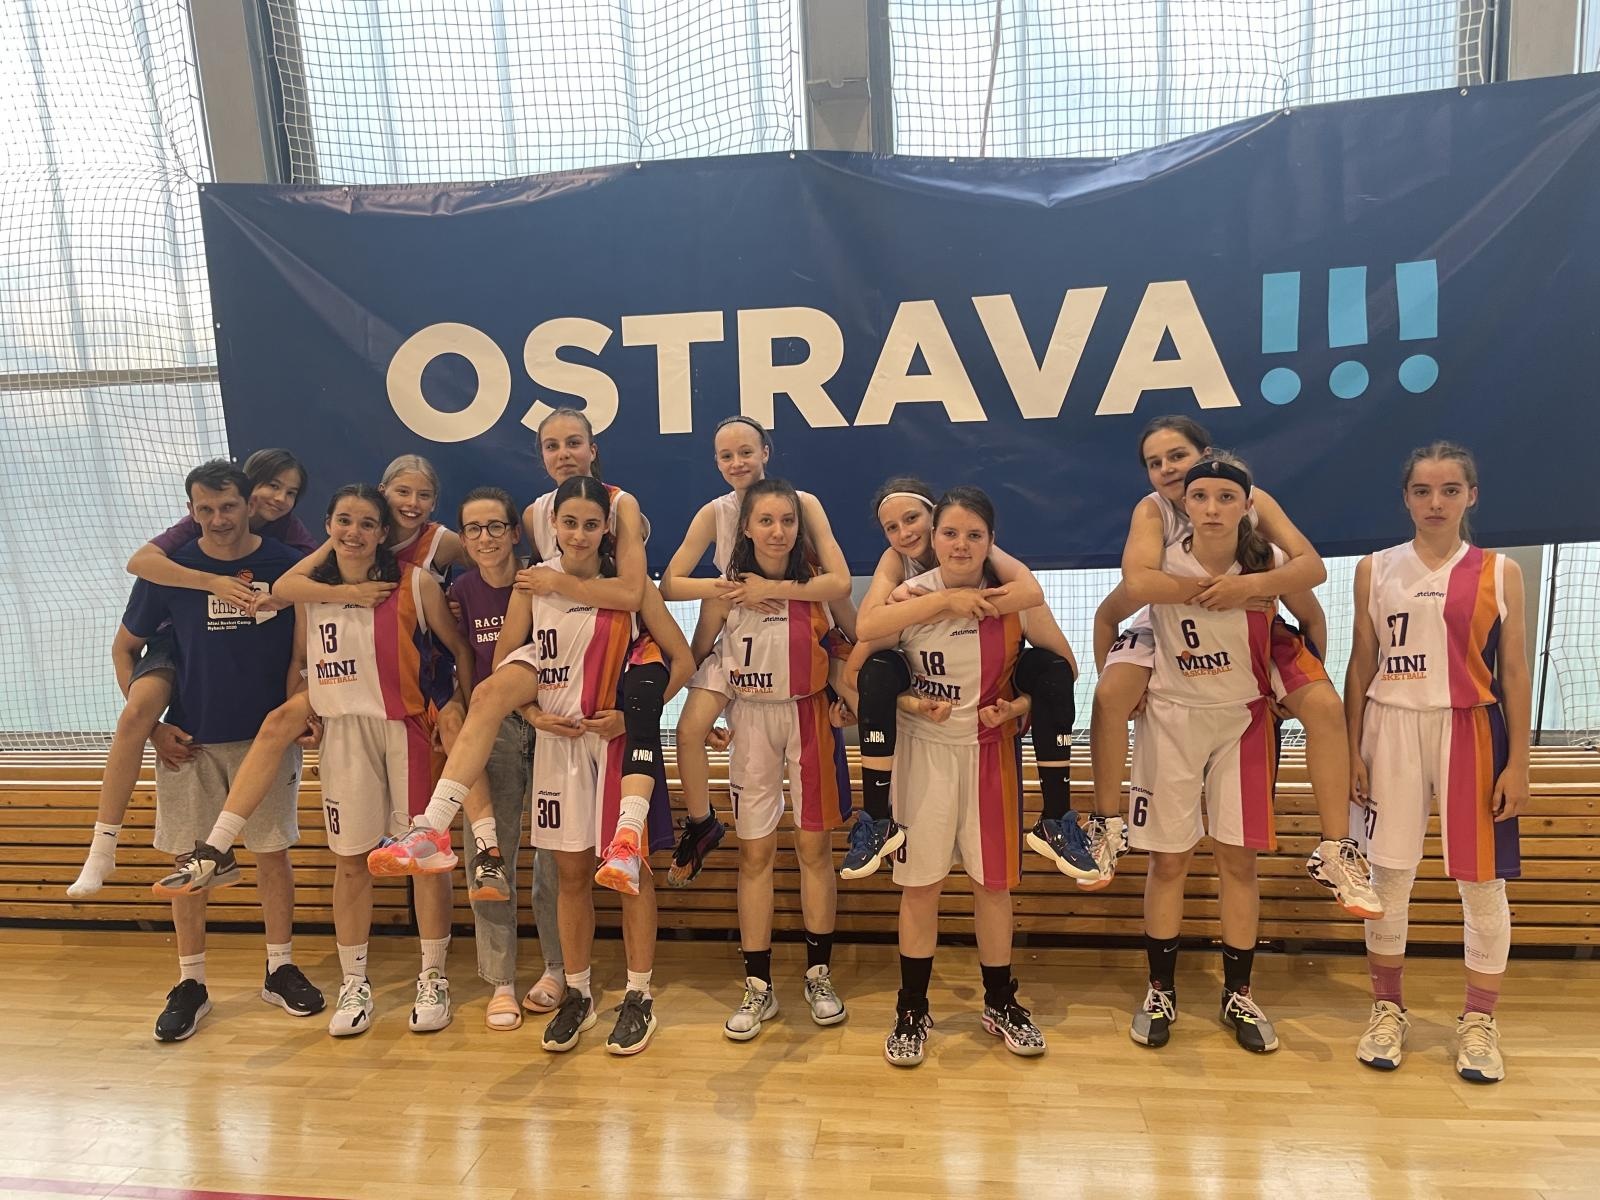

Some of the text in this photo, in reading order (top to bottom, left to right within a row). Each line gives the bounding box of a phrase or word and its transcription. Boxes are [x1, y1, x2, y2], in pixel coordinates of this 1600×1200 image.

[386, 259, 1439, 443] OSTRAVA!!!
[319, 623, 338, 654] 13
[537, 628, 558, 660] 30
[1181, 619, 1200, 649] 6
[742, 637, 753, 667] 7
[919, 650, 946, 676] 18
[1175, 651, 1231, 671] MINI
[316, 659, 357, 678] MINI
[730, 669, 773, 688] MINI
[1381, 671, 1427, 681] SKETBALL
[912, 674, 961, 701] MINI
[870, 731, 885, 743] NBA
[638, 749, 653, 763] NBA
[326, 805, 340, 835] 13
[537, 798, 560, 829] 30
[1133, 796, 1148, 827] 6
